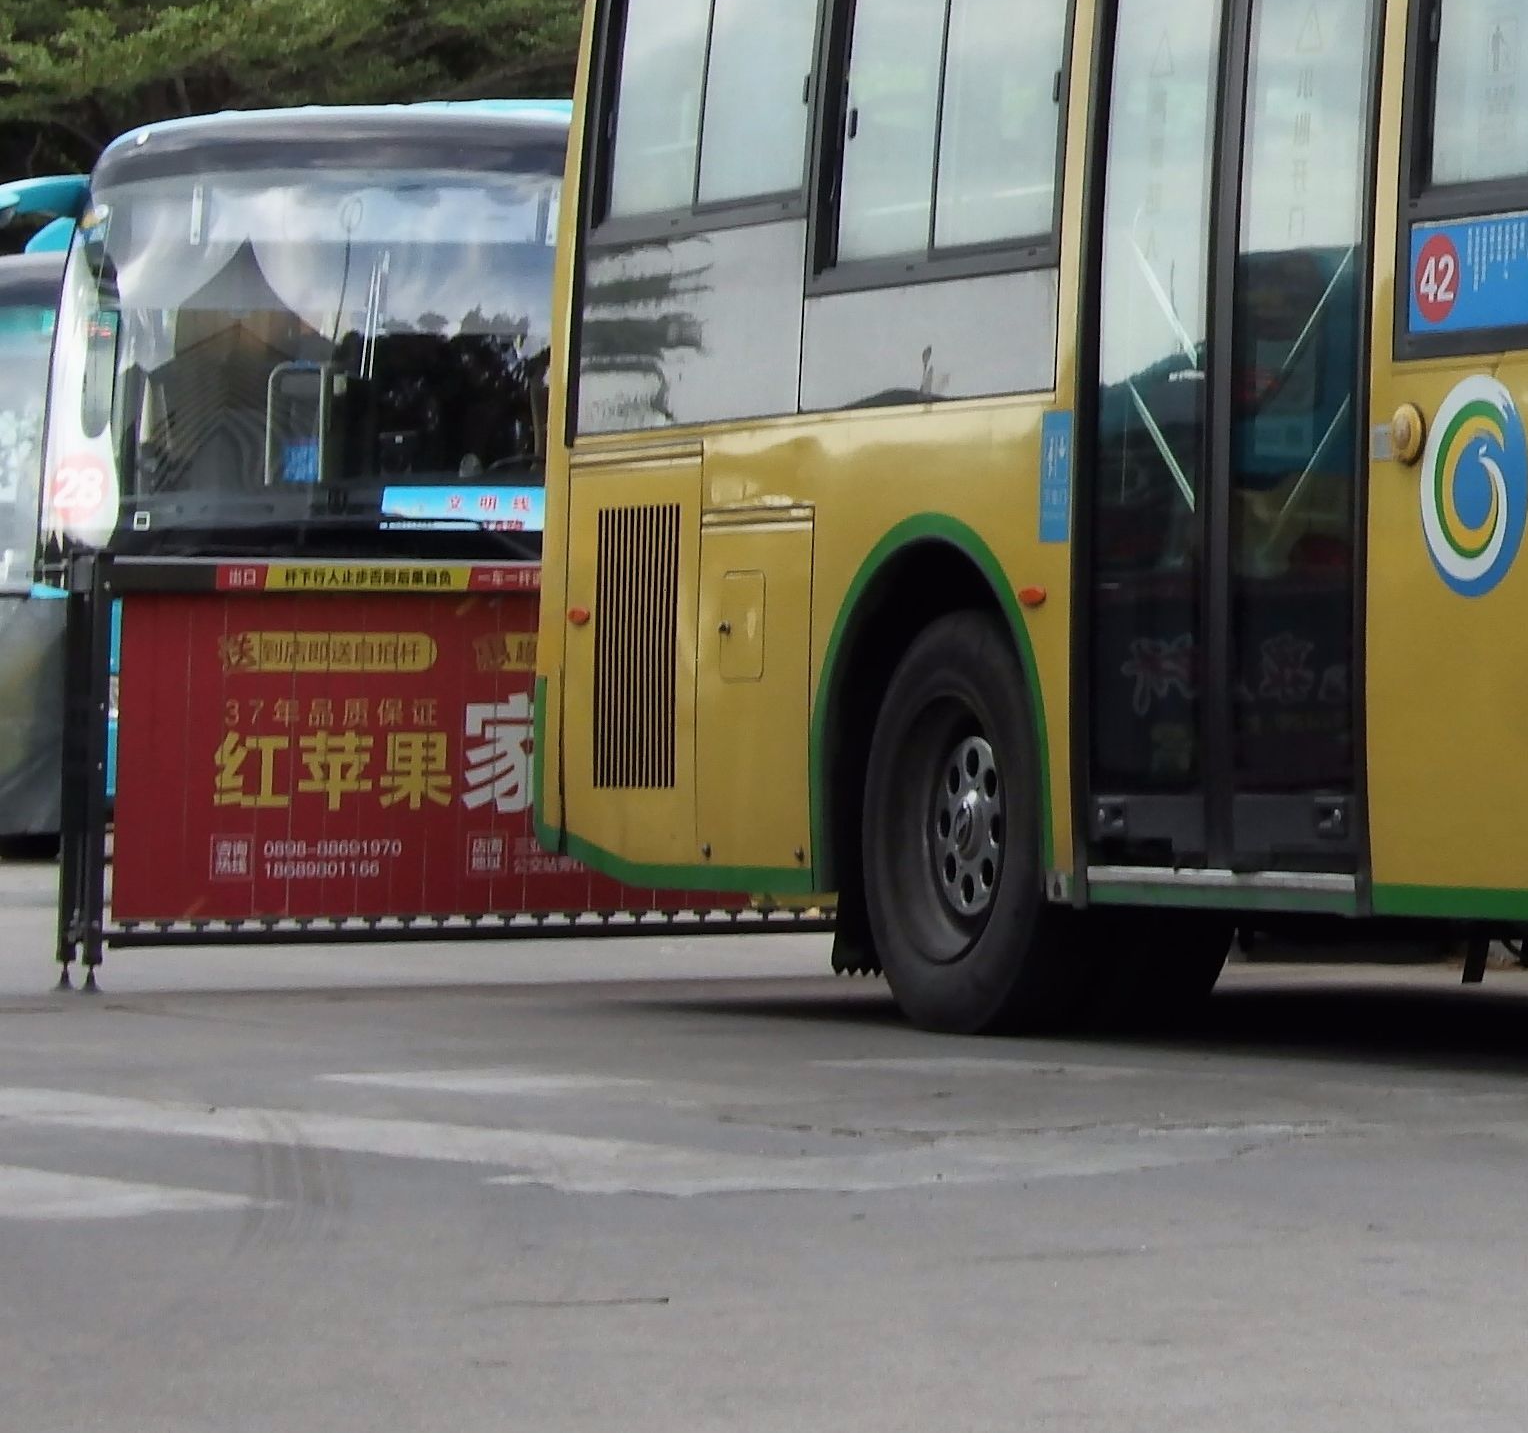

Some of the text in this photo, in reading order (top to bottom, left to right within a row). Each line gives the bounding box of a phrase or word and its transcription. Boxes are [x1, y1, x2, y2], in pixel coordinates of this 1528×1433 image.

[1420, 254, 1455, 304] 42
[53, 467, 104, 508] 28
[229, 569, 256, 586] 出口
[213, 730, 453, 811] 红苹果
